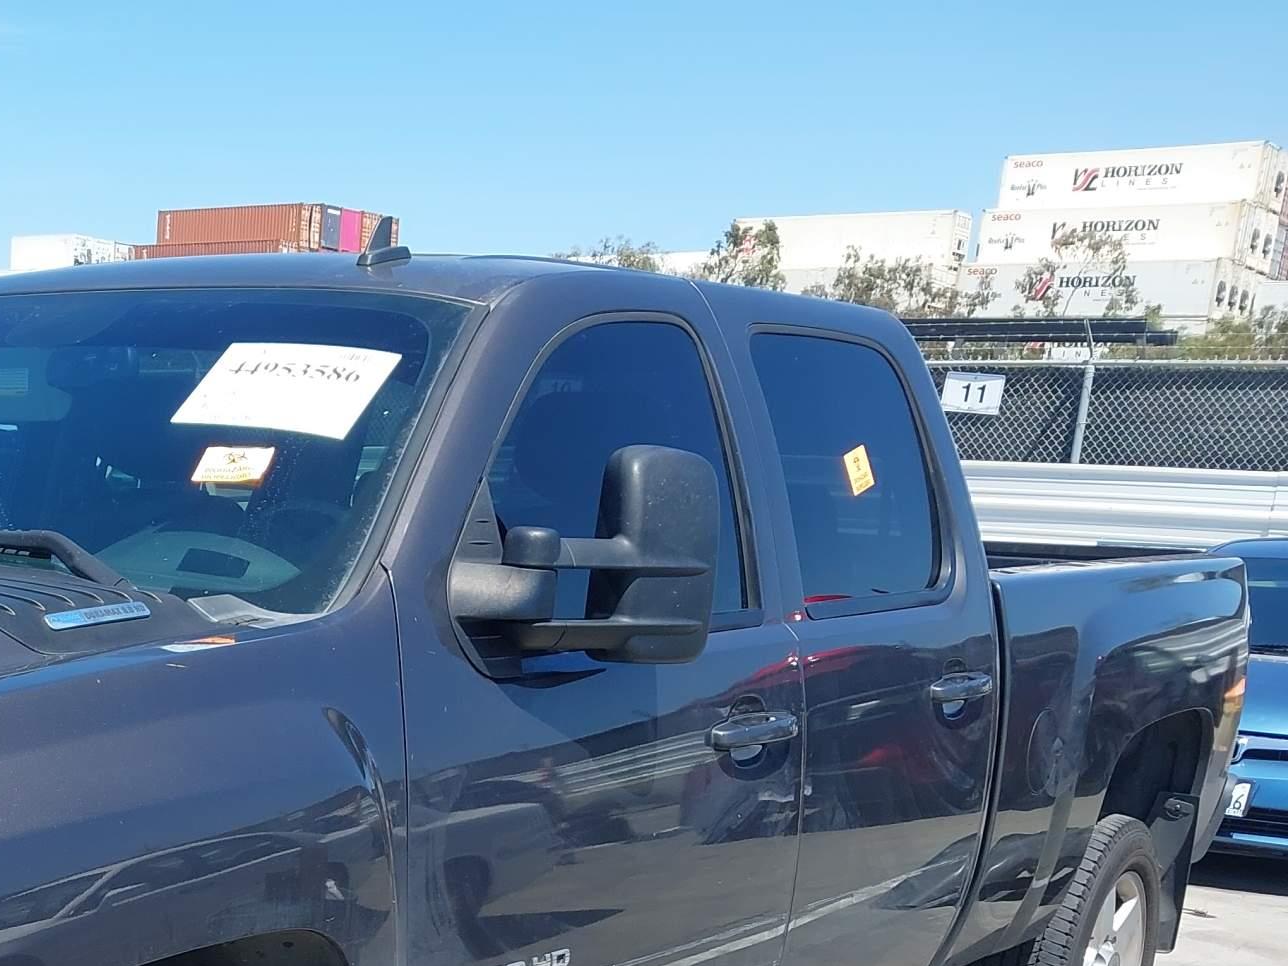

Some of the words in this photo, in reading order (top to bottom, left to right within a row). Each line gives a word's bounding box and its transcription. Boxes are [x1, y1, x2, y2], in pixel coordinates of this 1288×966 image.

[1013, 160, 1043, 168] seaco
[1104, 163, 1183, 178] HORIZON
[1101, 178, 1168, 187] LINES
[991, 213, 1021, 221] seaco
[1082, 219, 1160, 232] HORIZON
[967, 268, 997, 276] seaco
[1059, 275, 1137, 288] HORIZON
[961, 383, 987, 403] 11
